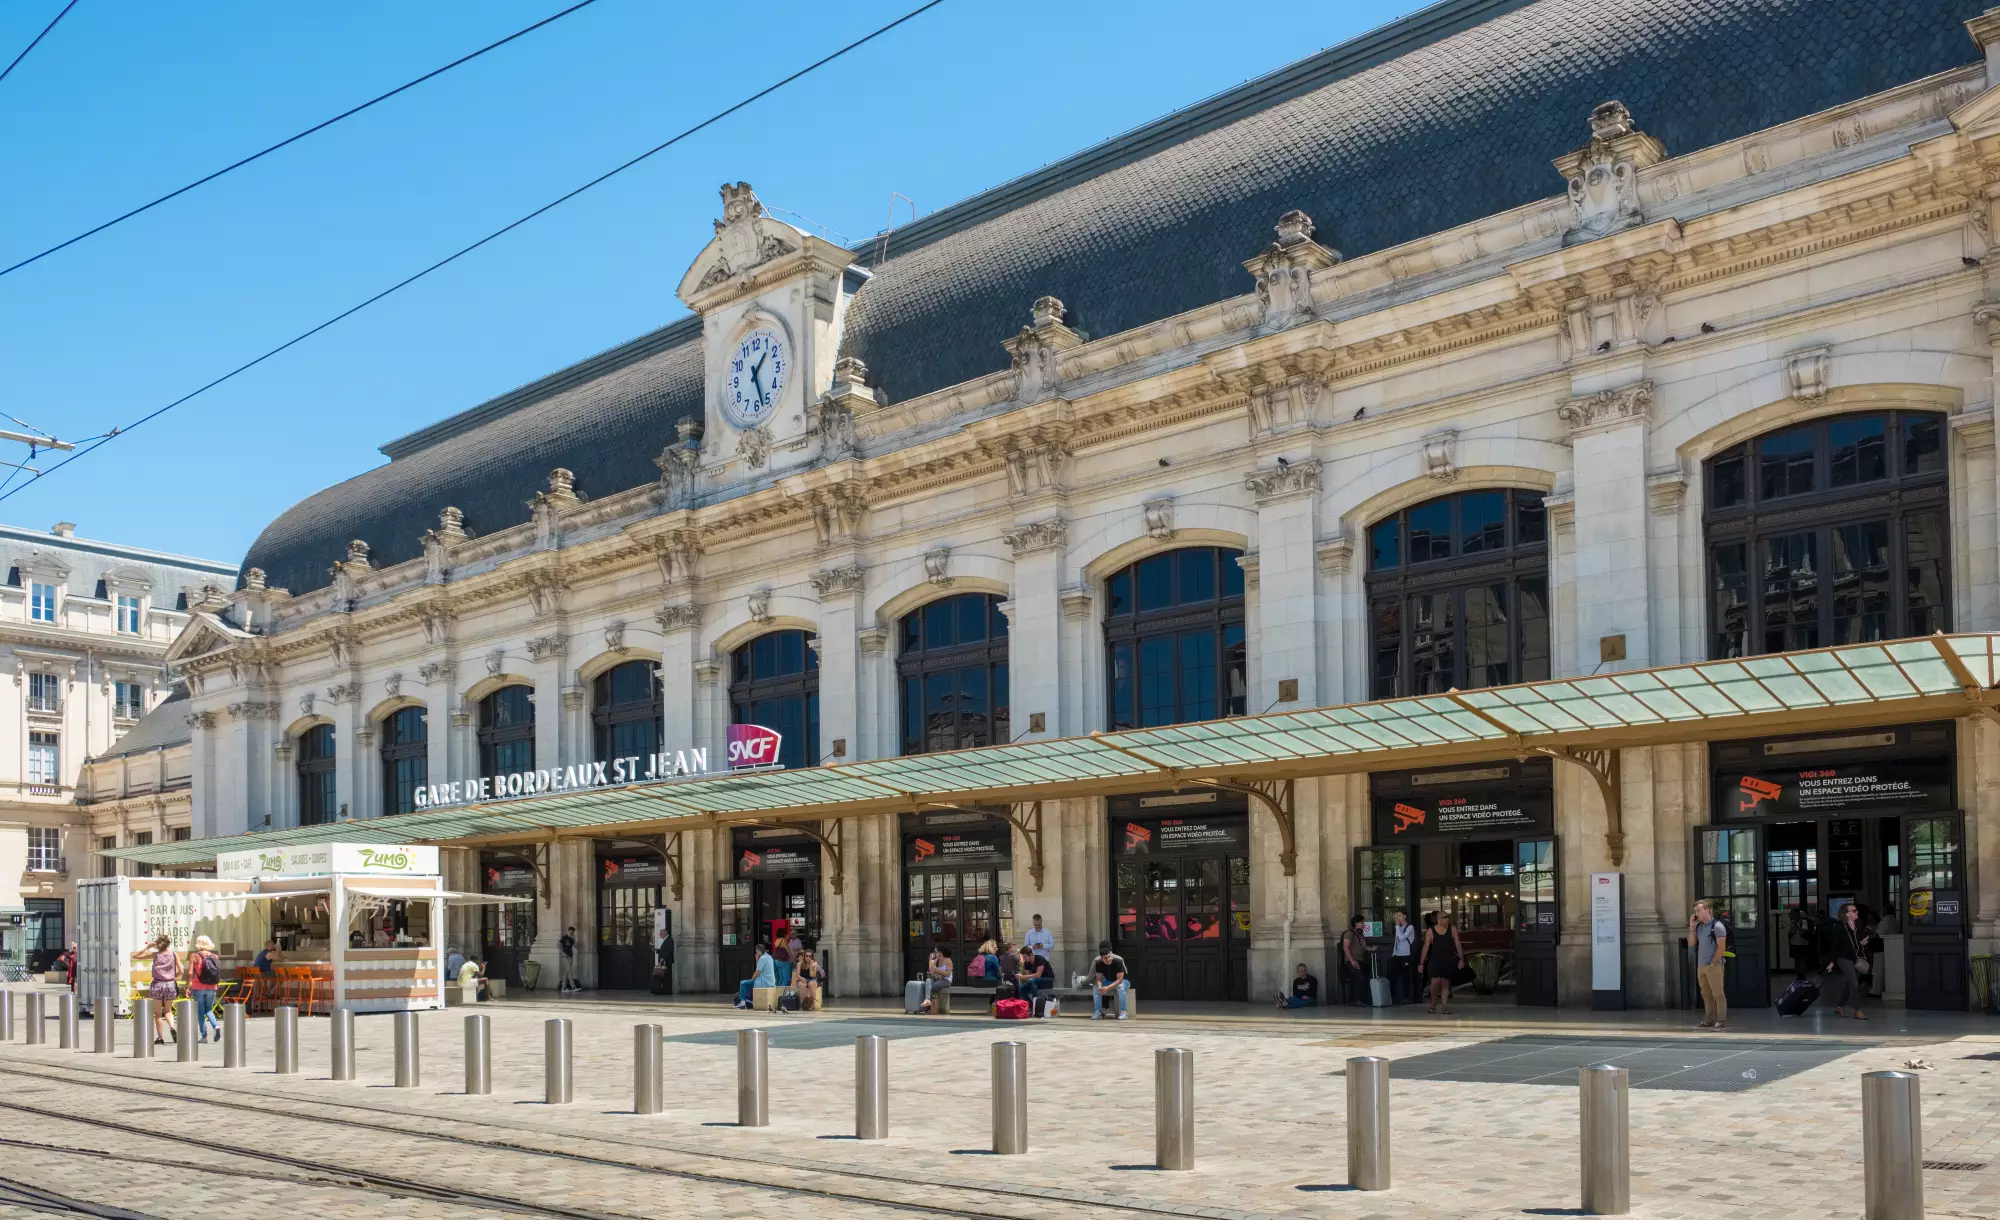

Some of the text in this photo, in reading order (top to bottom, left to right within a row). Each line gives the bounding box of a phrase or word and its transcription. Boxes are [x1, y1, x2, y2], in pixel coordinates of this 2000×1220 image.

[752, 338, 760, 351] 12
[765, 338, 768, 349] 1
[742, 345, 749, 358] 11
[772, 346, 777, 358] 2
[735, 360, 743, 372] 10
[775, 361, 780, 373] 3
[734, 376, 739, 388] 9
[772, 377, 777, 389] 4
[736, 391, 741, 403] 8
[765, 393, 770, 404] 5
[744, 399, 750, 412] 7
[754, 400, 759, 412] 6
[728, 737, 774, 762] SNCF
[414, 748, 708, 807] GARE DE BORDEAUX ST JEAN
[1822, 778, 1853, 786] ENTREZ
[1813, 787, 1842, 795] ESPACE
[1844, 784, 1869, 793] VIDÉO
[291, 853, 327, 865] SALADES SOUPES
[150, 905, 194, 915] BAR A JUS
[150, 917, 171, 926] CAFE
[151, 927, 189, 937] SALADES
